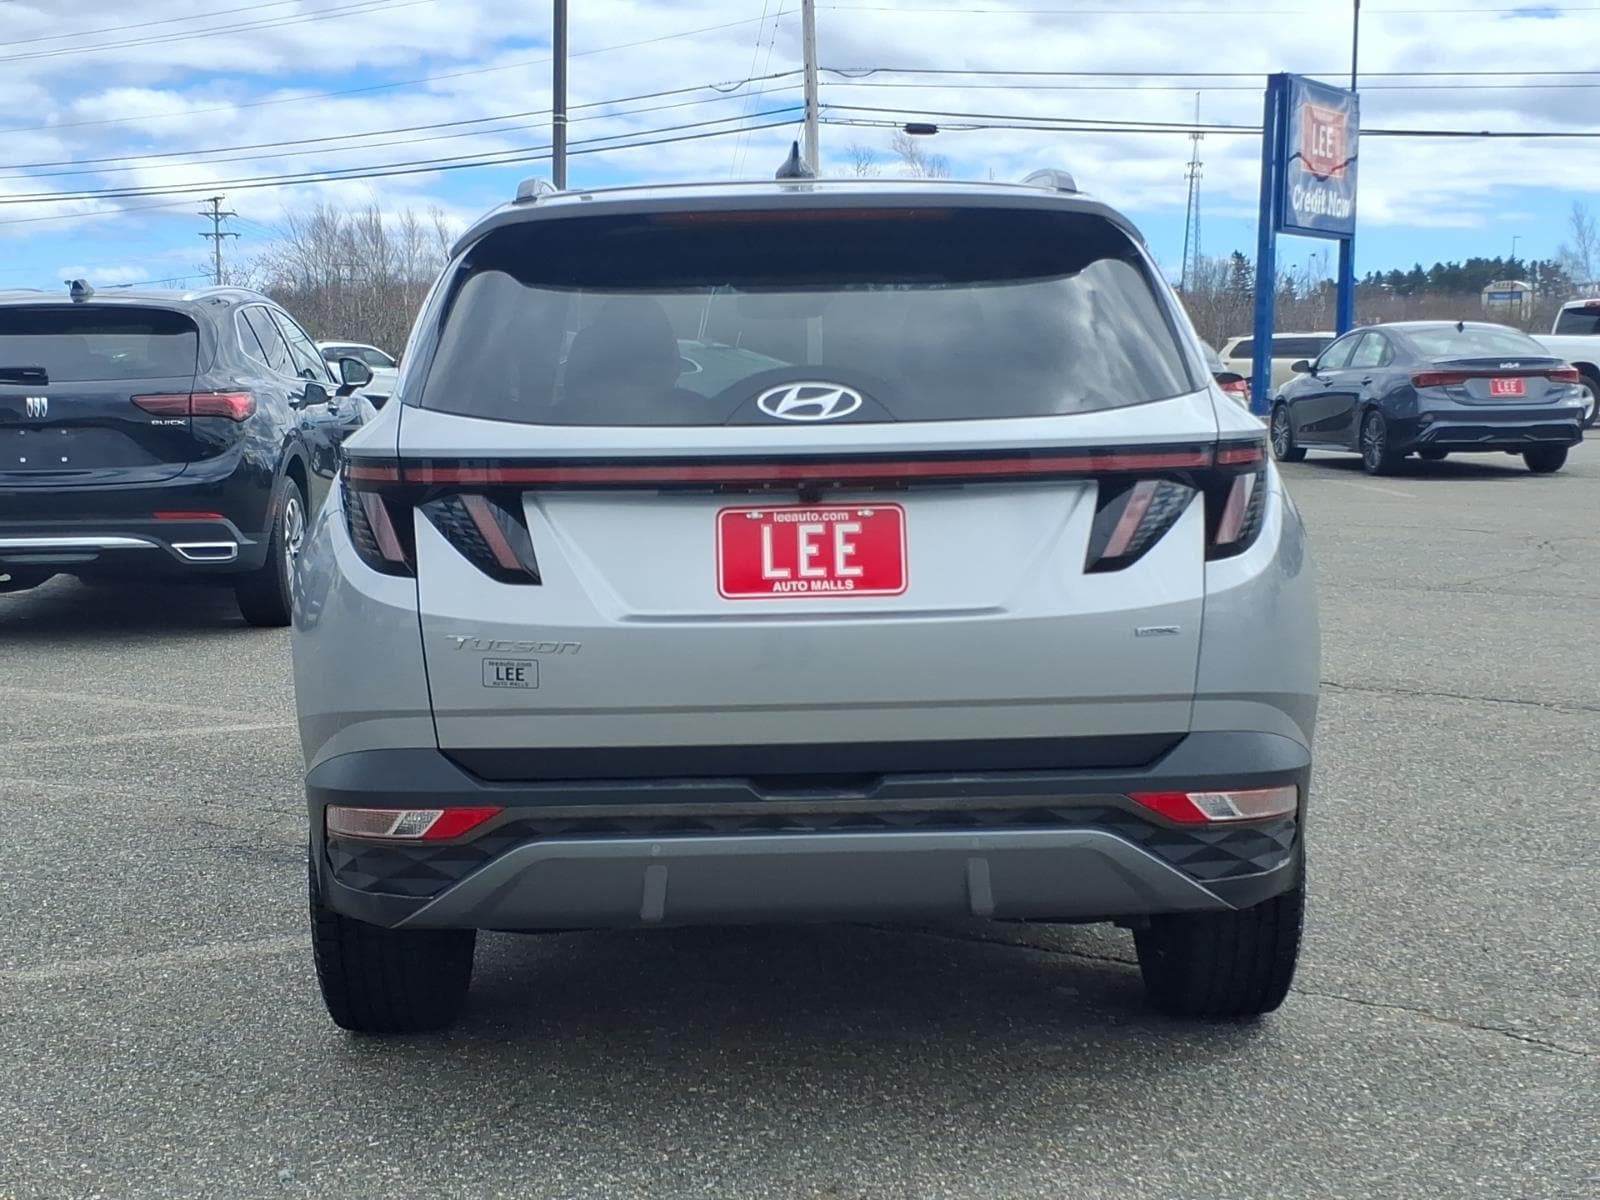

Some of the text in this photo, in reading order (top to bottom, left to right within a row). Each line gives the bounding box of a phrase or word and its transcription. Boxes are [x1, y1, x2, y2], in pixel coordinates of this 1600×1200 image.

[1312, 122, 1335, 159] LEE
[1292, 184, 1350, 218] Credit Now
[1497, 381, 1517, 392] LEE
[773, 511, 849, 523] leeauto.com
[761, 522, 864, 580] LEE
[772, 579, 854, 592] AUTO MALLS
[495, 667, 525, 682] LEE
